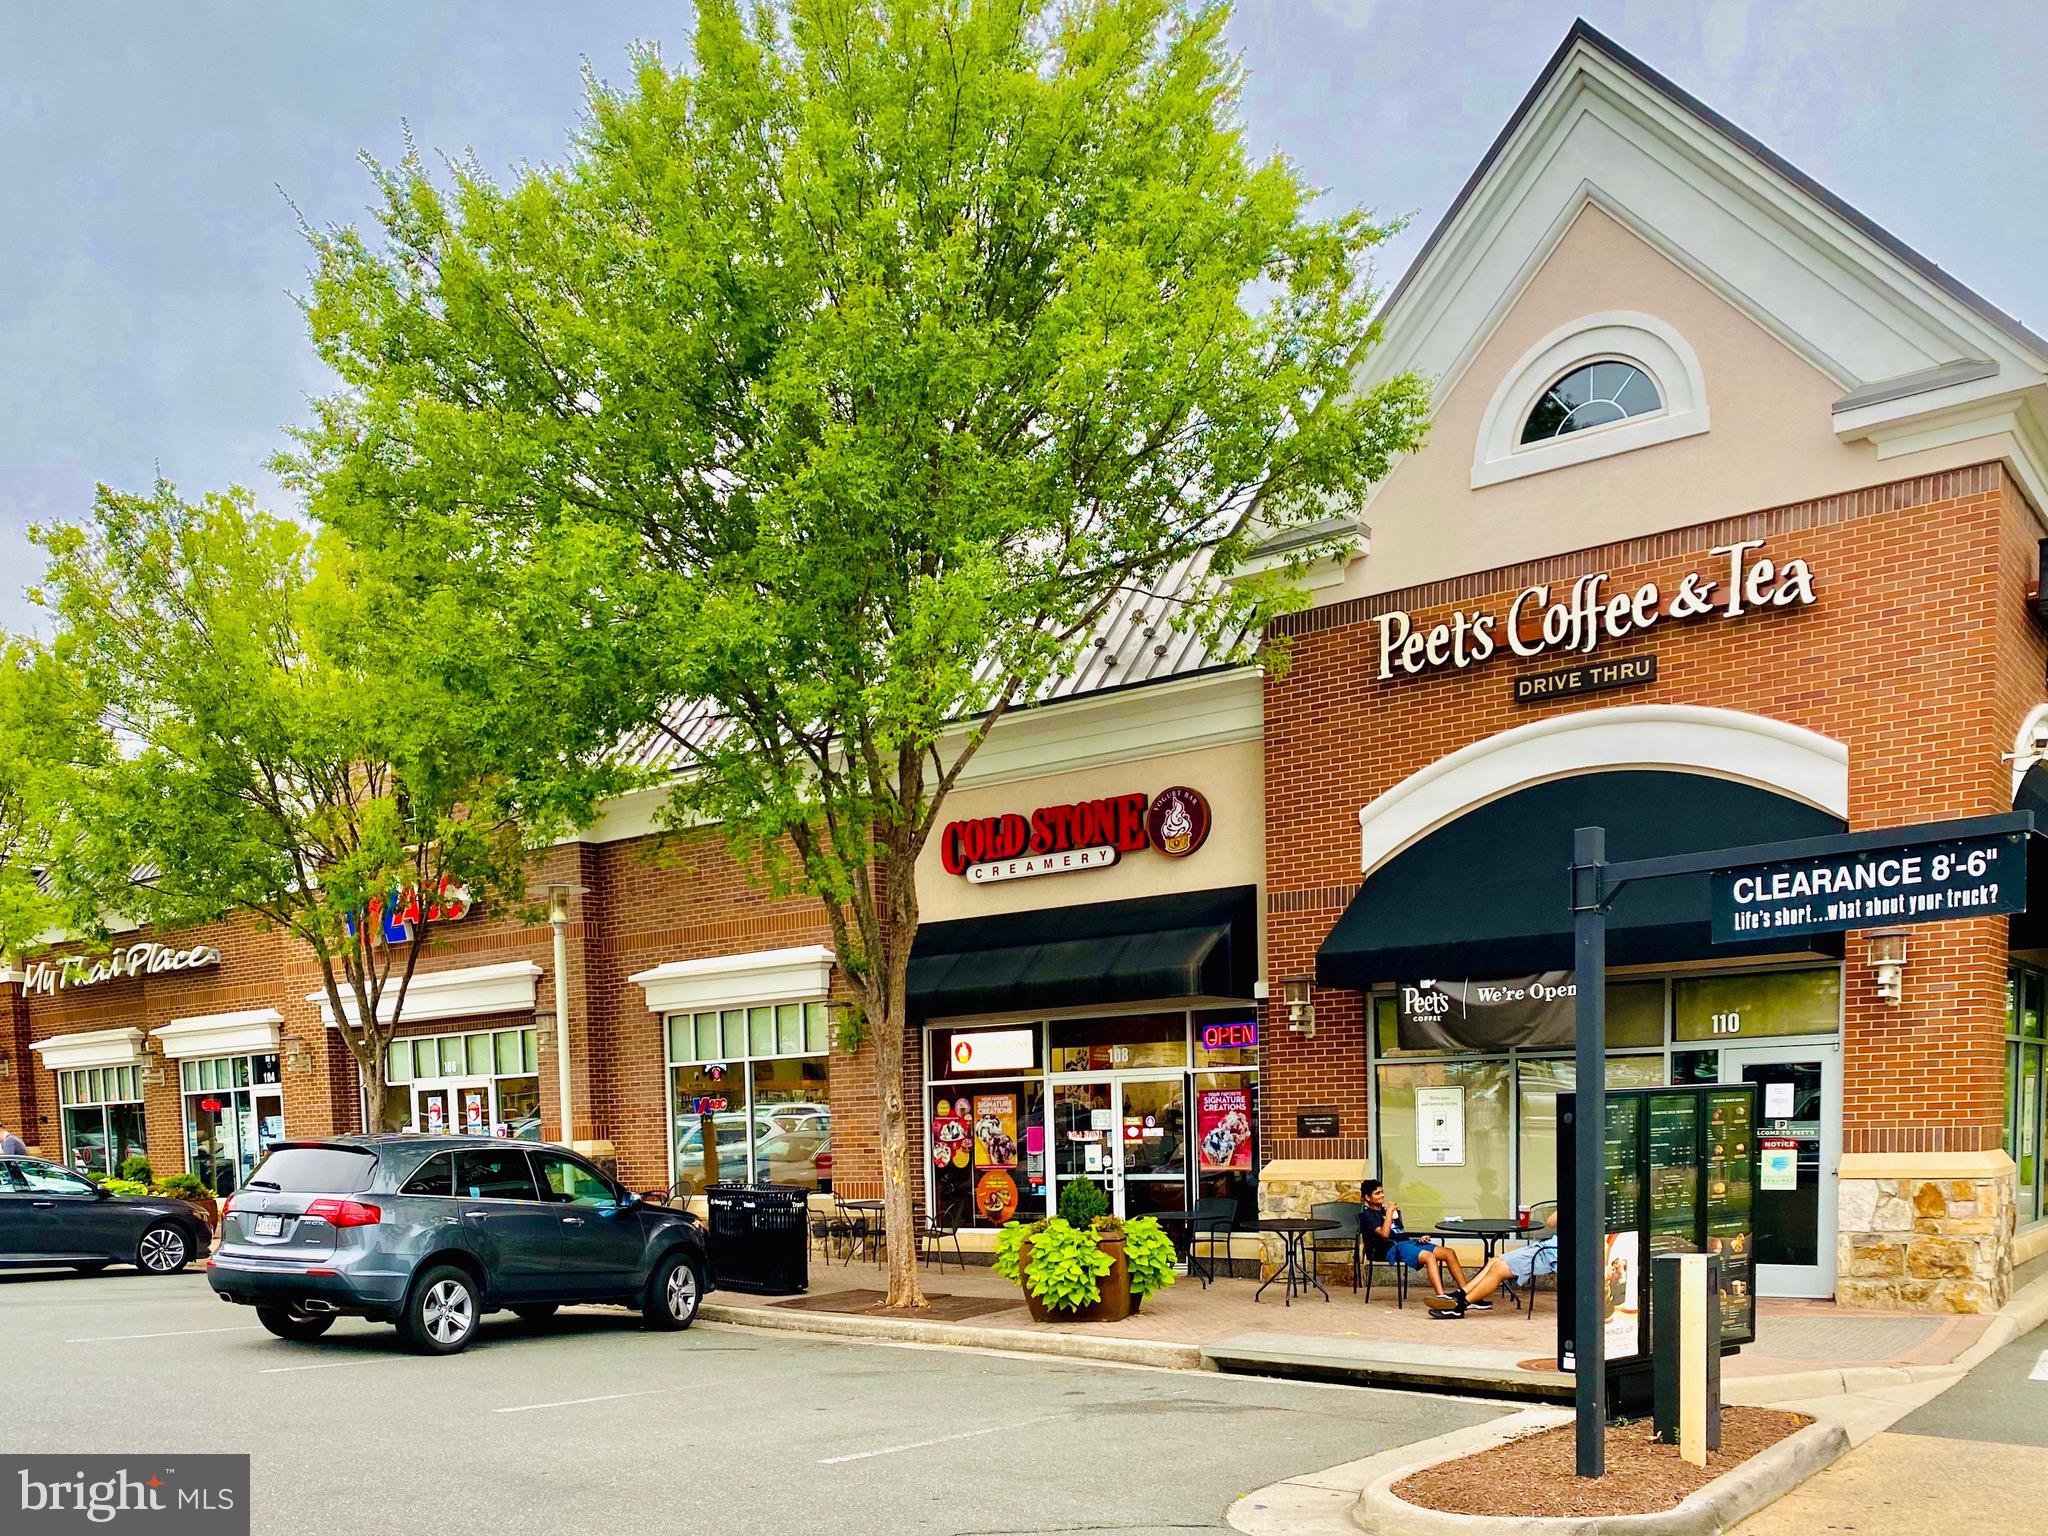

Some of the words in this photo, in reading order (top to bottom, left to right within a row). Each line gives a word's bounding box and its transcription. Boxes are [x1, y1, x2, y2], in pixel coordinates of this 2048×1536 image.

[1372, 609, 1497, 680] Peet's
[1507, 573, 1659, 657] Coffee
[1668, 572, 1718, 618] &
[1709, 539, 1817, 619] Tea
[1519, 673, 1582, 697] DRIVE
[1589, 659, 1652, 684] THRU
[1153, 789, 1183, 812] YOGURT
[1183, 790, 1198, 806] BAR
[941, 814, 1030, 876] COLD
[1030, 793, 1149, 855] STONE
[975, 850, 1107, 879] CREAMERY
[1733, 856, 1922, 904] CLEARANCE
[1865, 895, 1905, 917] about
[1909, 892, 1943, 915] your
[1947, 883, 1999, 908] truck?
[22, 962, 55, 998] My
[126, 942, 210, 978] Place
[1402, 987, 1449, 1014] Peet's
[1477, 986, 1525, 1003] We're
[1529, 983, 1576, 1002] Open
[1205, 1025, 1255, 1047] OPEN
[1711, 1012, 1740, 1034] 110
[1107, 1047, 1129, 1063] 108
[1204, 1096, 1246, 1104] SIGNATURE
[1204, 1103, 1246, 1112] CREATIONS
